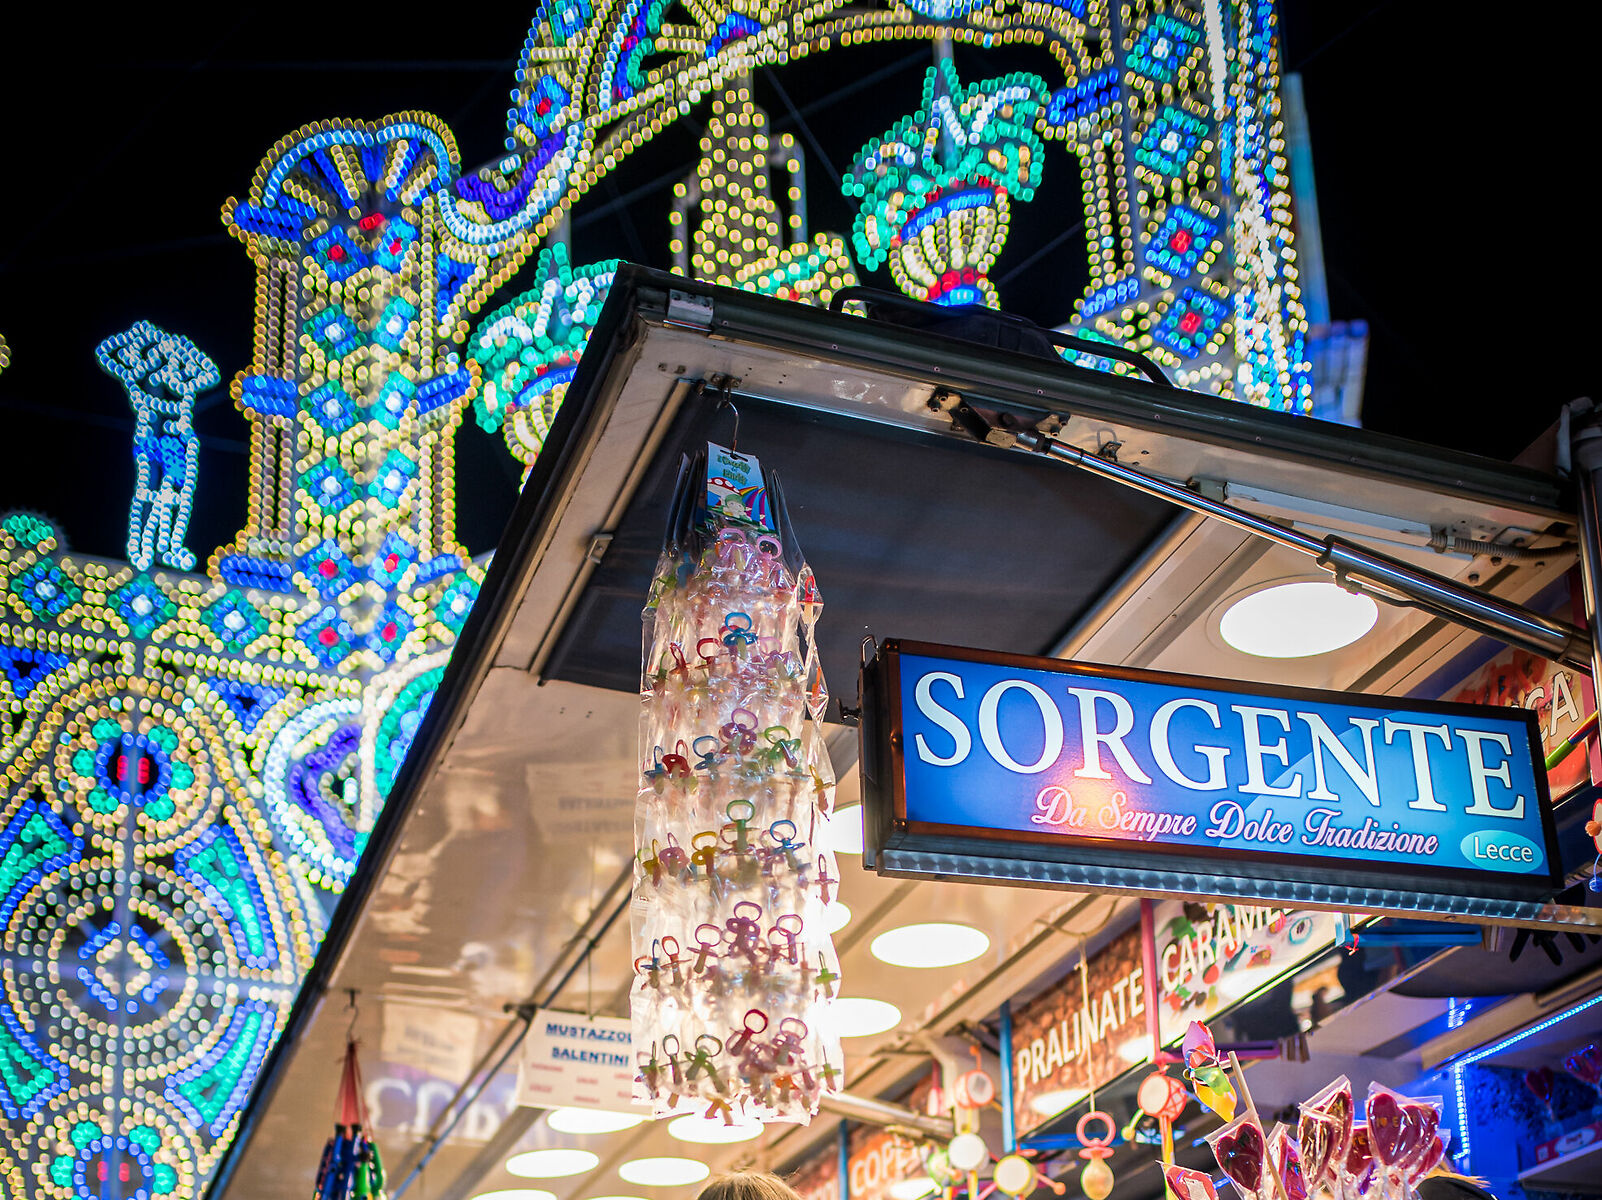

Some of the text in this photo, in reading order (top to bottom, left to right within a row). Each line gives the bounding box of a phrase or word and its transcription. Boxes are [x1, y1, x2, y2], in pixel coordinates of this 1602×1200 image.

[914, 671, 1525, 819] SORGENTE
[1031, 785, 1439, 855] Da Sempre Dolce Tradizione
[1474, 836, 1533, 863] Lecce
[1017, 967, 1145, 1093] PRALINATE
